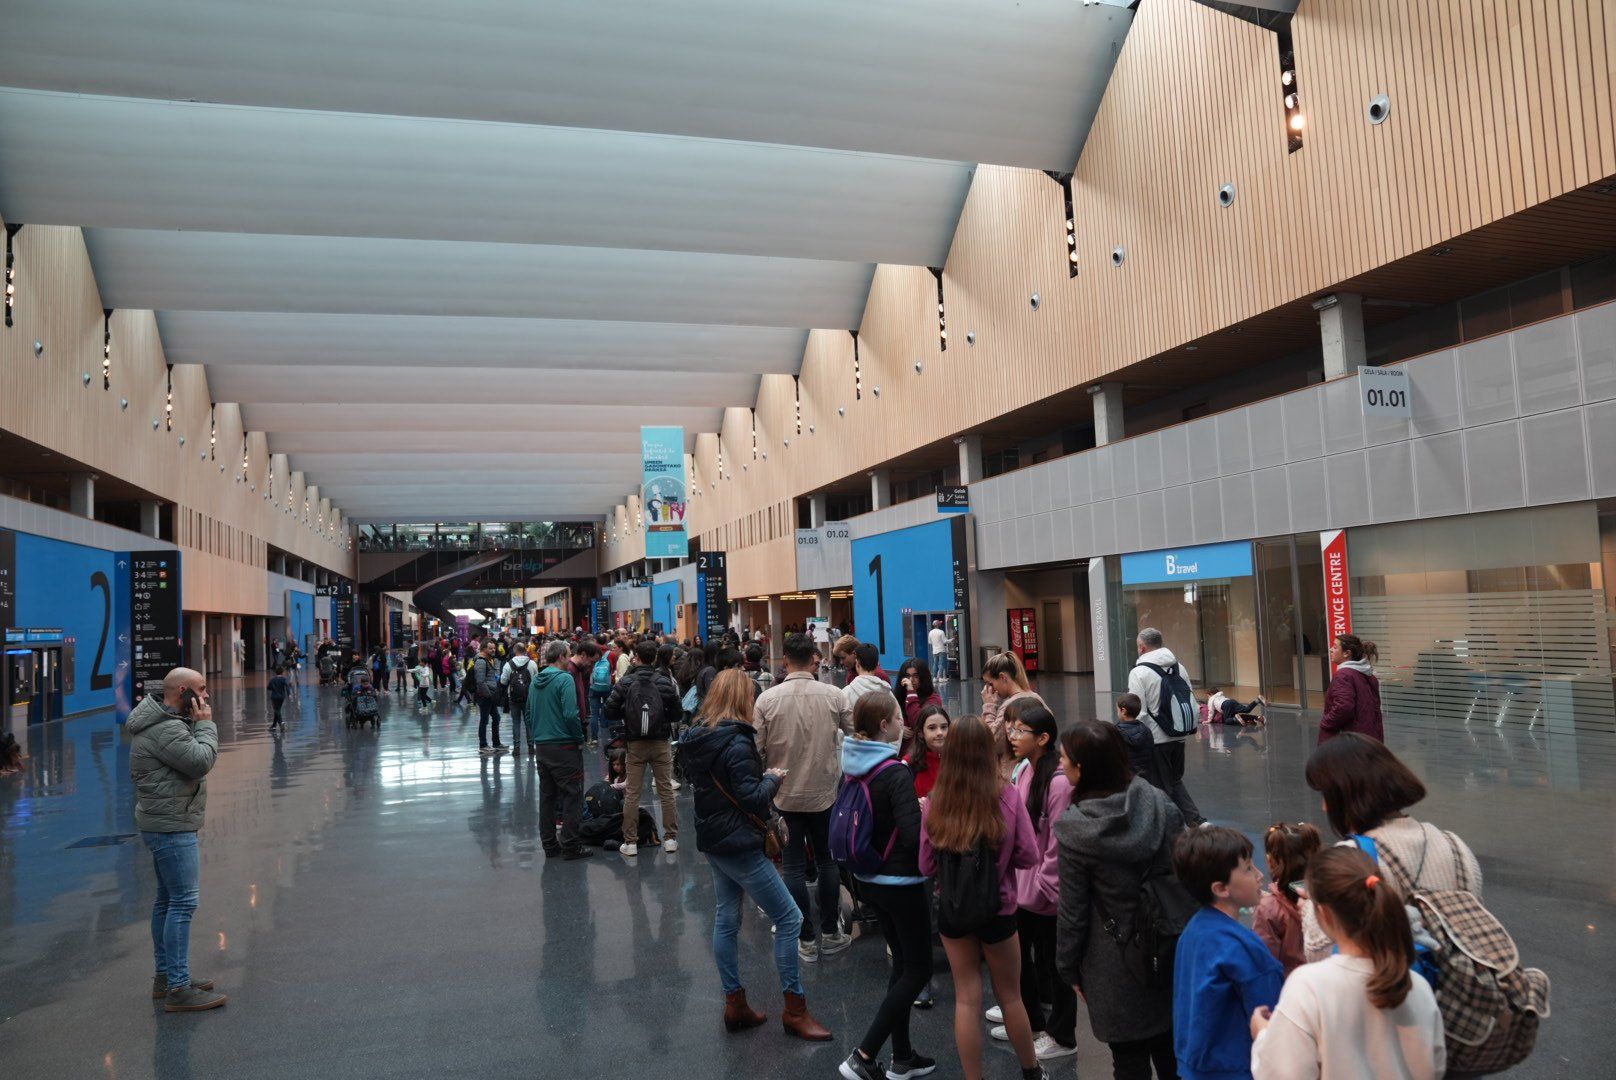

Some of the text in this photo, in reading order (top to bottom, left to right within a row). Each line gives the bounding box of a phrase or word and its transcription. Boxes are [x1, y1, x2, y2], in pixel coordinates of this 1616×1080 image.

[1367, 389, 1406, 407] 01.01
[826, 530, 849, 538] 01.02
[699, 556, 724, 568] 2 1
[1176, 562, 1198, 574] travel
[1329, 552, 1344, 595] CENTRE
[333, 586, 352, 595] 2 1
[868, 554, 885, 655] 1
[1333, 597, 1346, 636] ERVICE
[89, 571, 112, 691] 2
